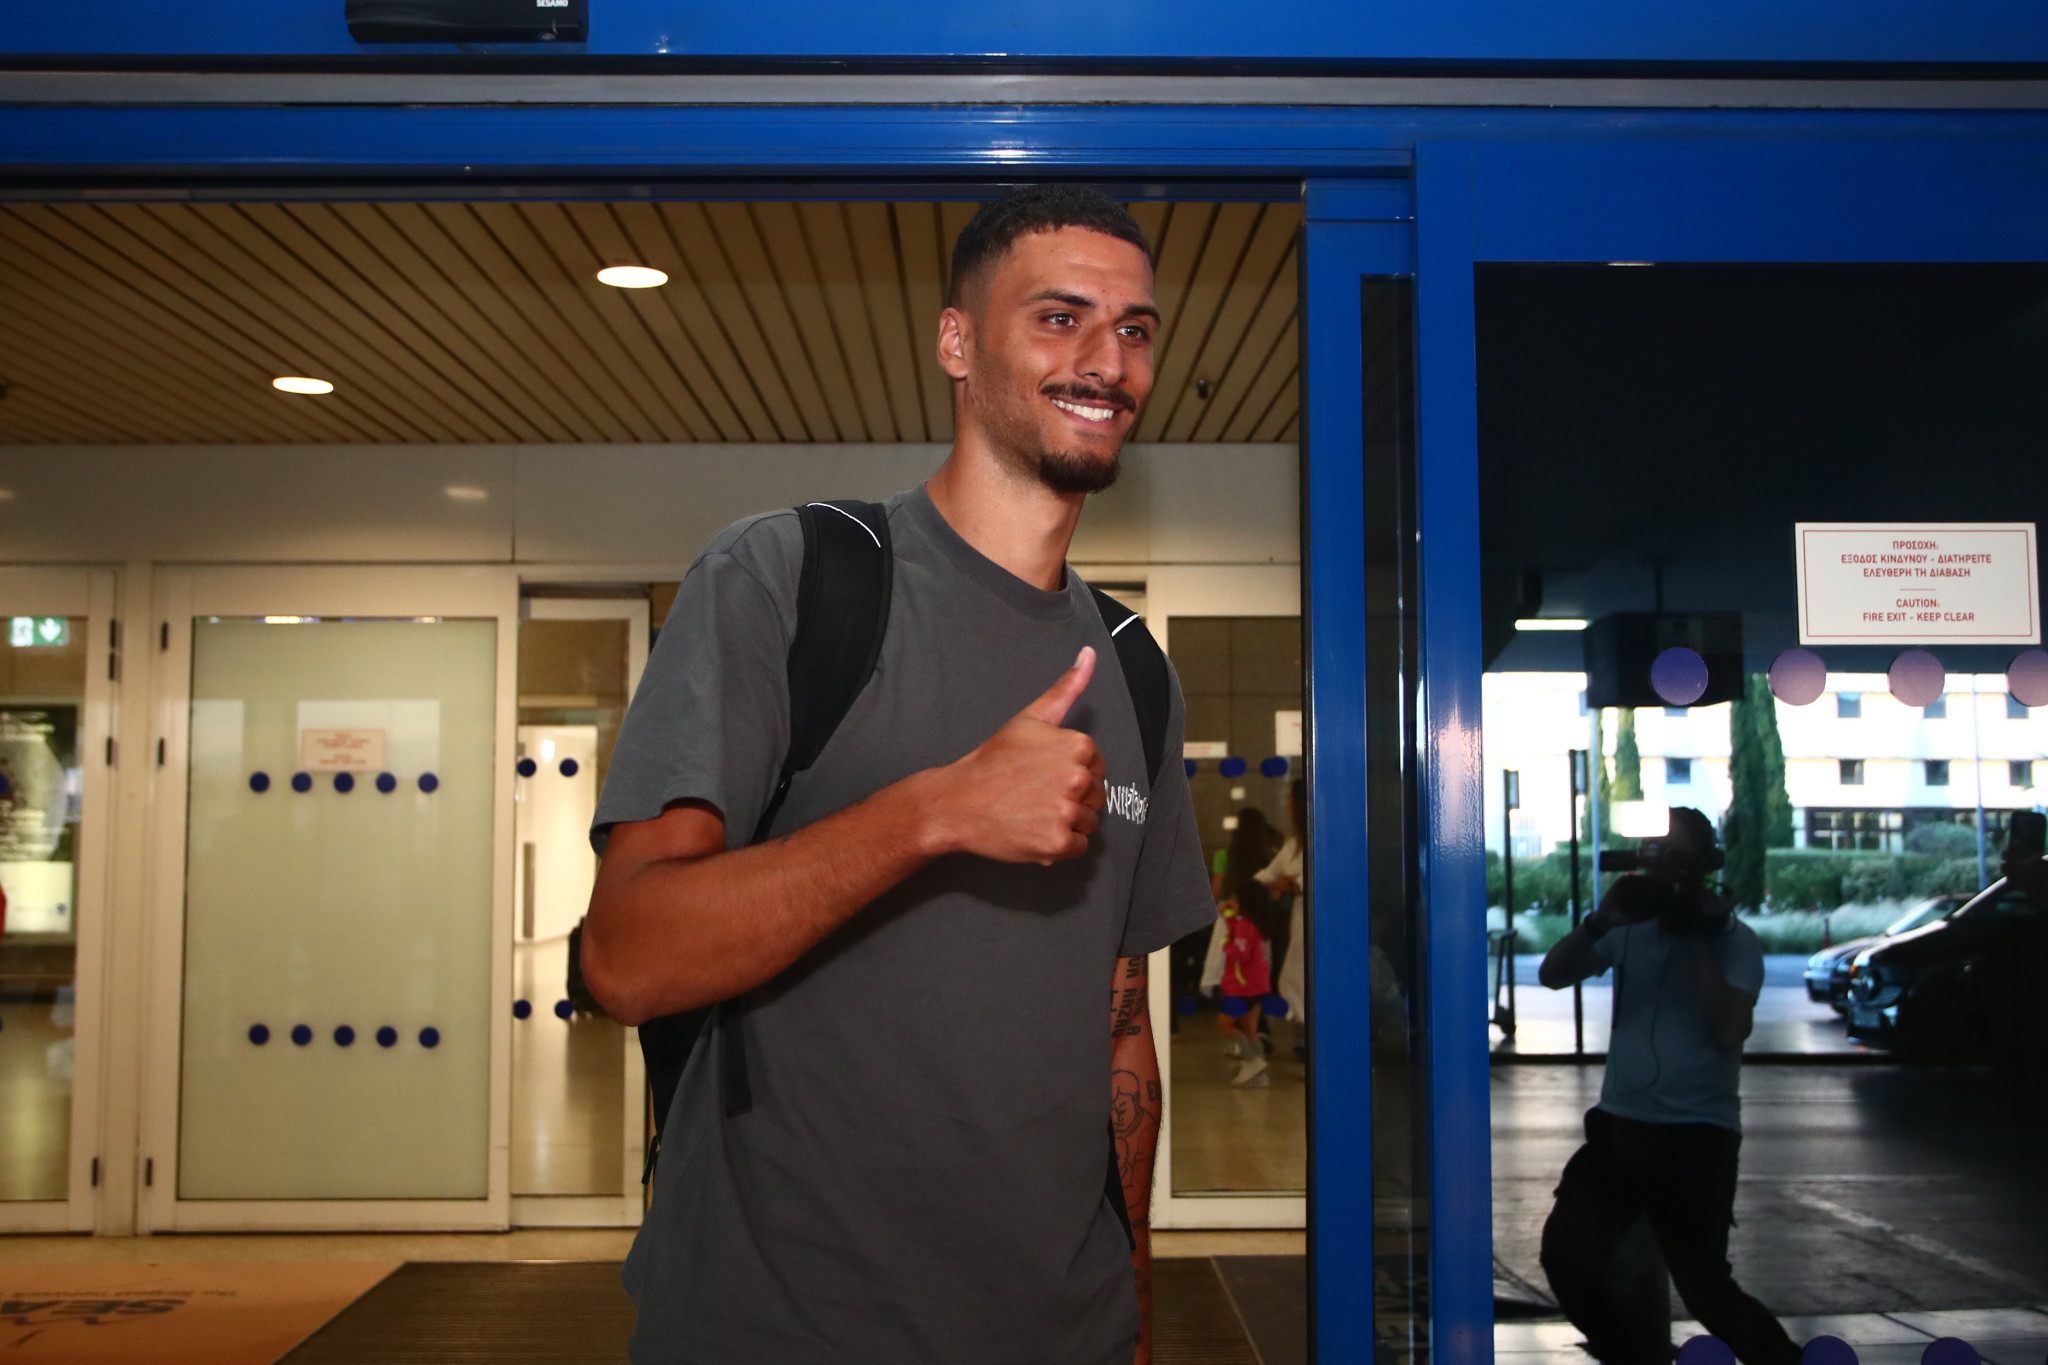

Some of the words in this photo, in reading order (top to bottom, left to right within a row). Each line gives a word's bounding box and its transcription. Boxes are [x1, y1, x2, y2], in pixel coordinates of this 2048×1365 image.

[1841, 554, 1878, 564] ΕΞΟΔΟΣ
[1880, 554, 1928, 564] ΚΙΝΔΥΝΟΥ
[1937, 554, 1992, 564] ΔΙΑΤΗΡΕΙΤΕ
[1863, 567, 1912, 577] ΕΛΕΥΘΕΡΗ
[1914, 567, 1927, 577] ΤΗ
[1929, 567, 1971, 577] ΔΙΑΒΑΣΗ
[1862, 612, 1884, 622] FIRE
[1886, 612, 1907, 622] EXIT
[1916, 612, 1942, 622] KEEP
[1943, 612, 1975, 622] CLEAR
